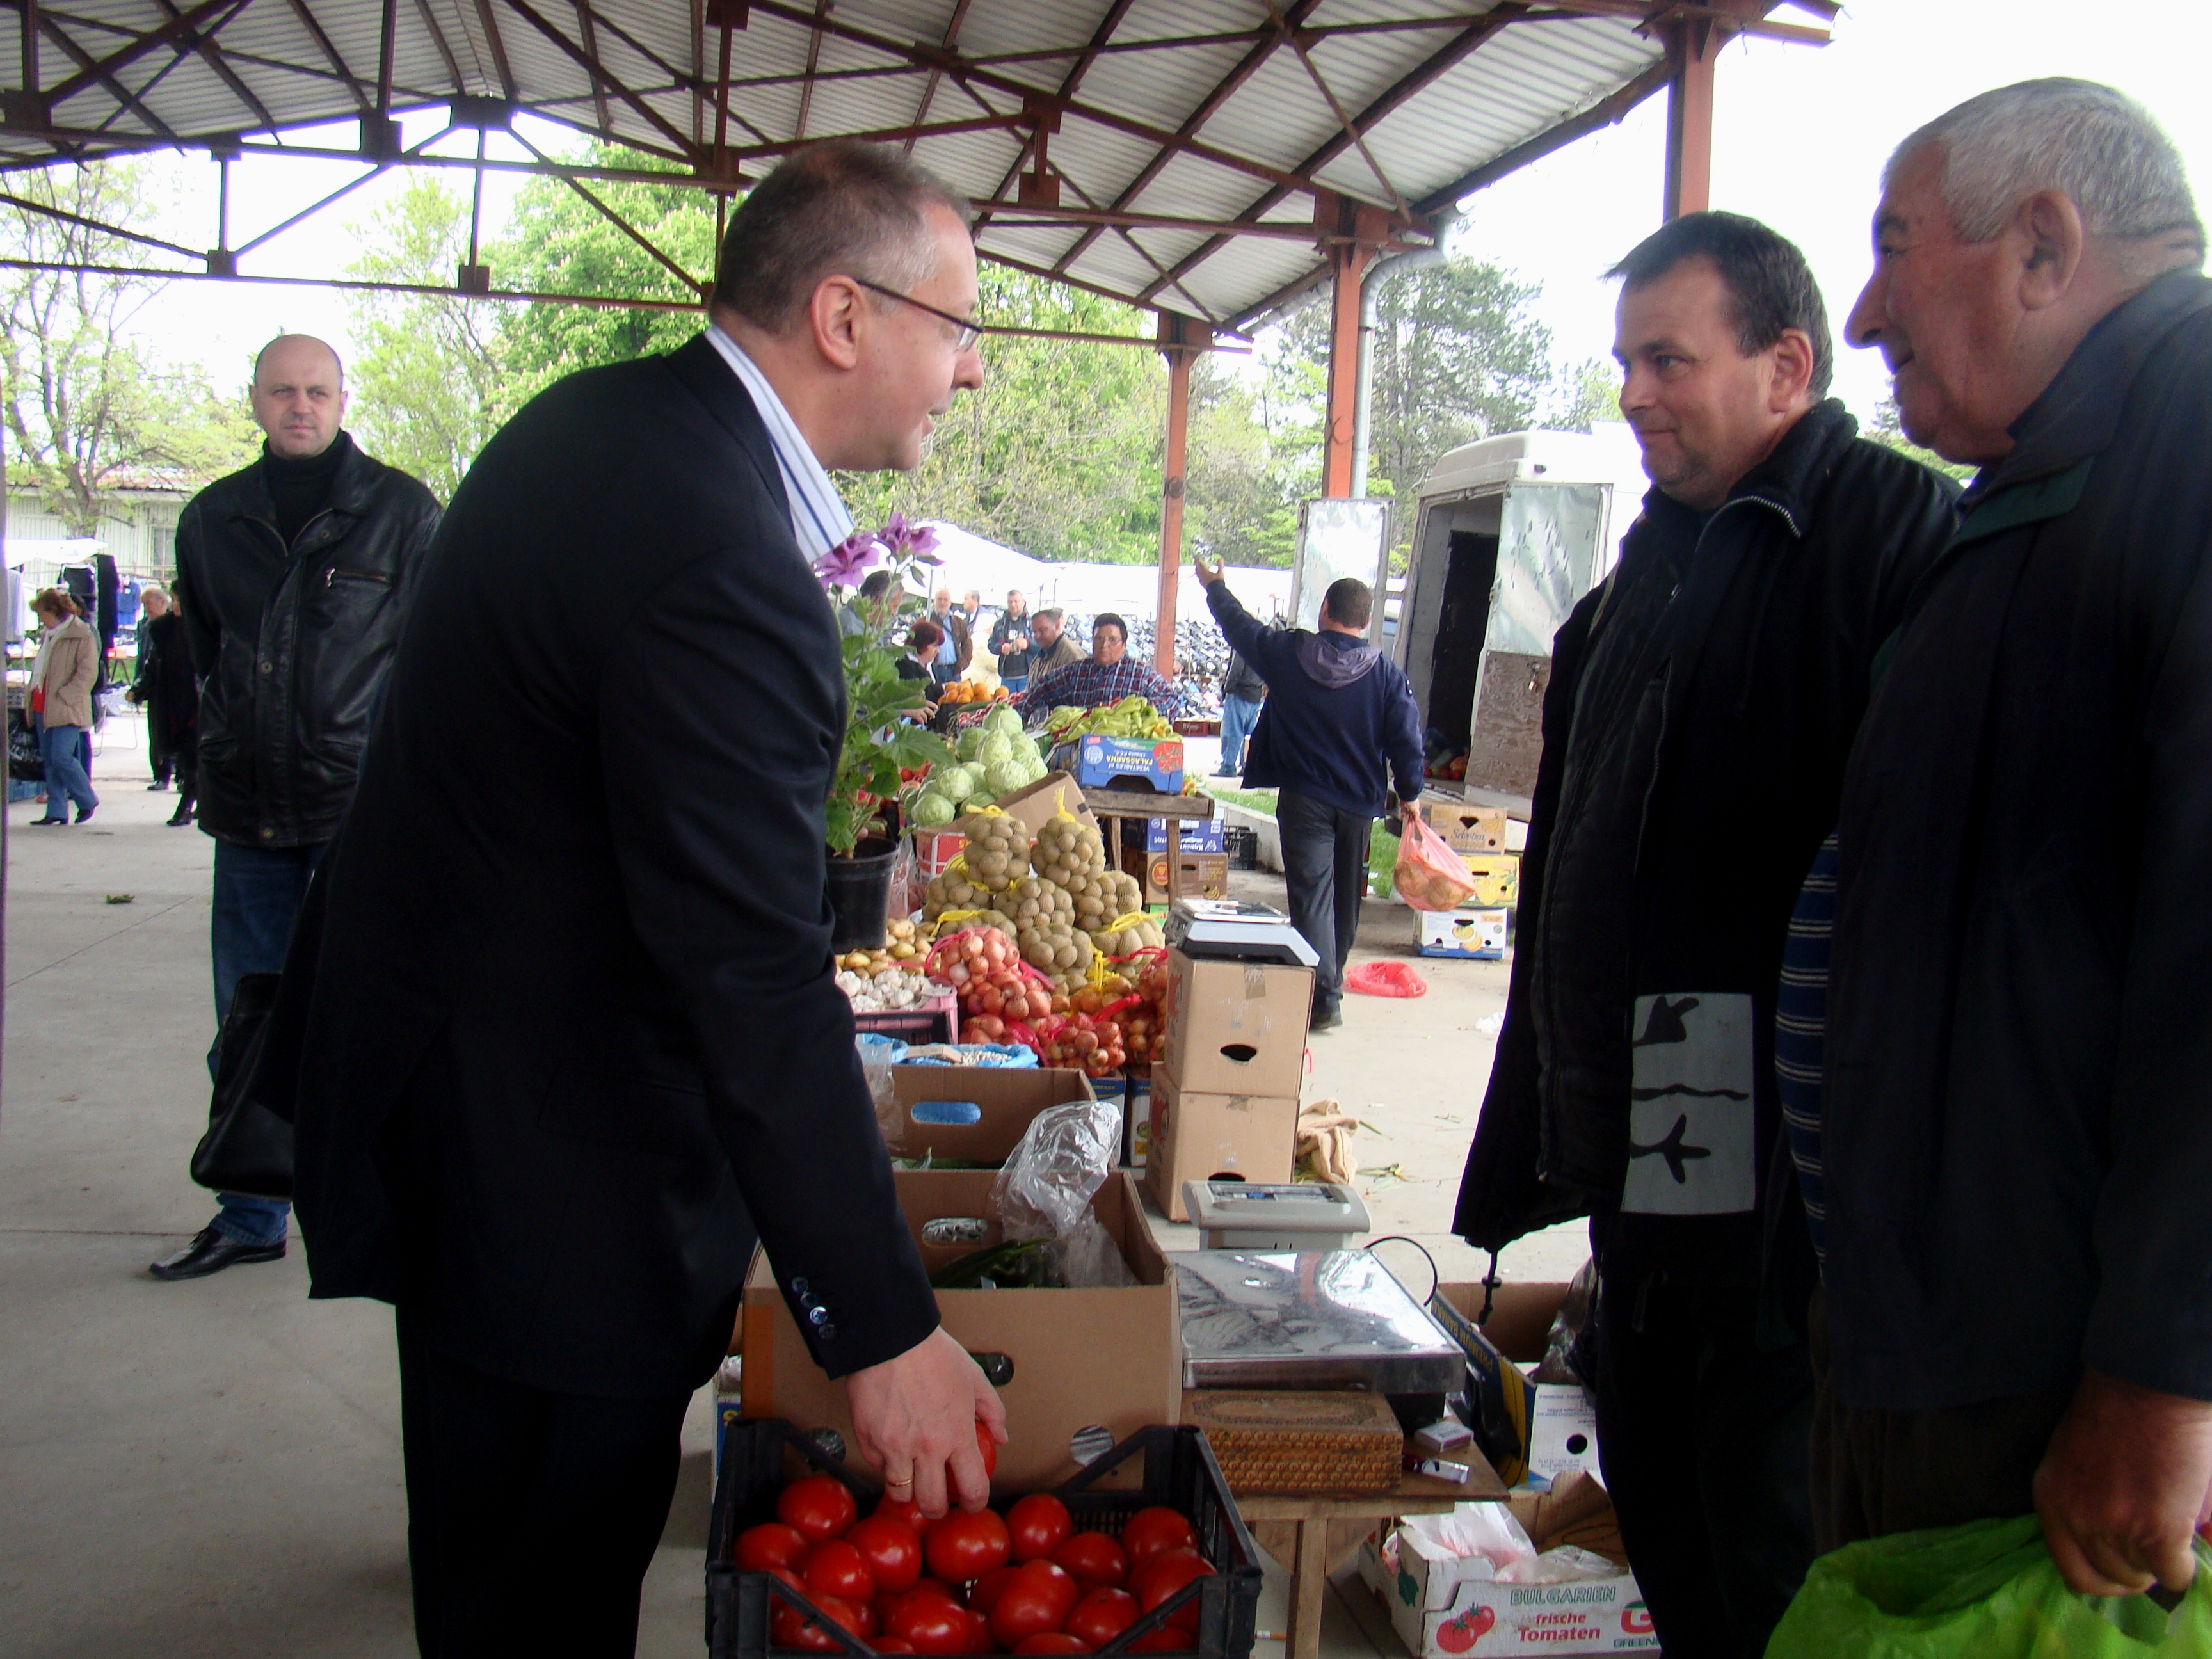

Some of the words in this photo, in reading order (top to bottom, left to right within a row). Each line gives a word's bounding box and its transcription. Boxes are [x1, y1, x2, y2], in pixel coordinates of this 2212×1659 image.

[1116, 763, 1150, 772] VEGETABLES
[1460, 1327, 1493, 1372] PREMIUM
[1510, 1585, 1616, 1606] BULGARIEN
[1536, 1612, 1587, 1626] frische
[1518, 1626, 1601, 1642] Tomaten
